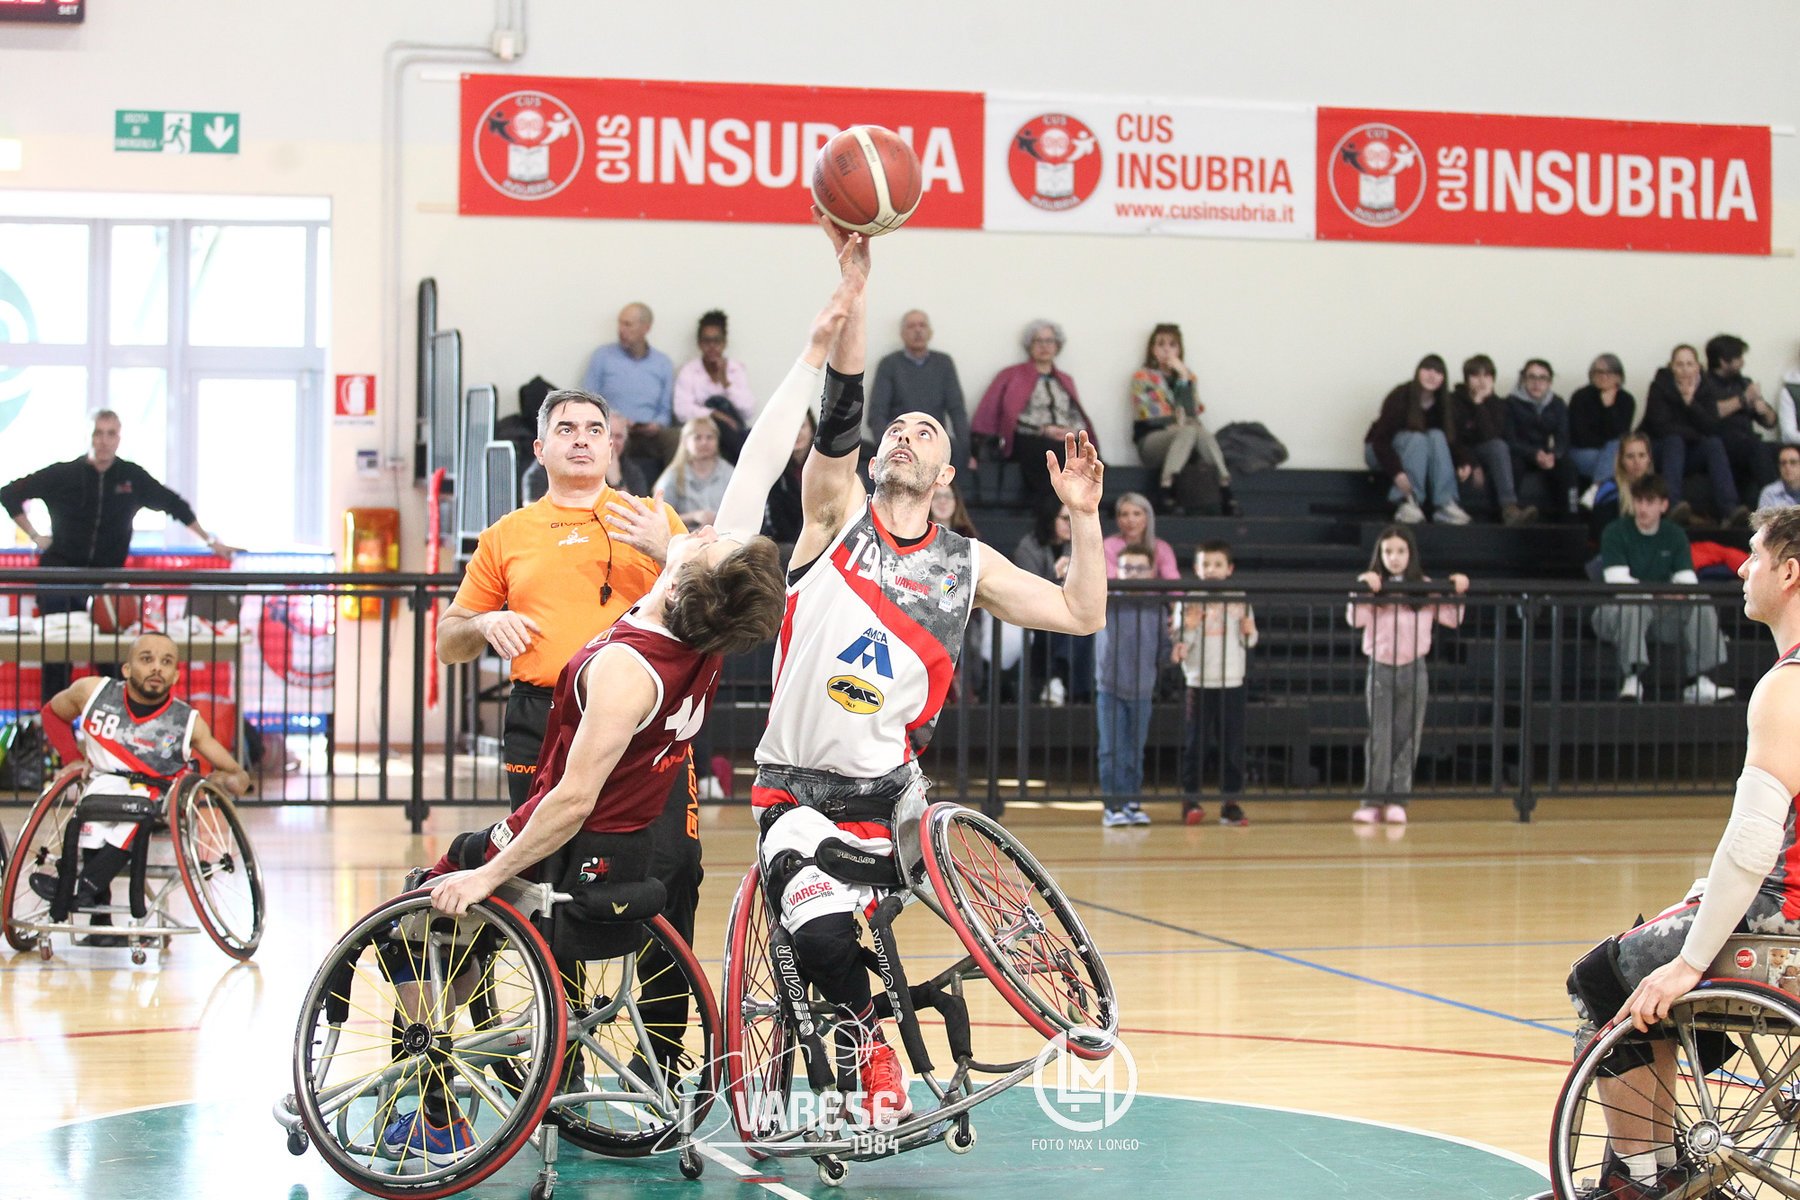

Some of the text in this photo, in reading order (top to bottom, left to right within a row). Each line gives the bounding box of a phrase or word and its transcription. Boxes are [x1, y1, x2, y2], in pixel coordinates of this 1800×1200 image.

[58, 5, 79, 15] SET
[1116, 112, 1173, 143] CUS
[595, 114, 631, 184] CUS
[637, 116, 964, 193] INSUA
[1116, 152, 1294, 195] INSUBRIA
[1437, 146, 1468, 212] CUS
[1473, 147, 1758, 222] INSUBRIA
[1115, 201, 1294, 223] www.cusinsubria.it
[844, 531, 881, 580] 19
[895, 575, 930, 595] VARESE
[862, 627, 888, 644] AMCA
[88, 709, 121, 740] 58
[788, 881, 832, 906] VARESE
